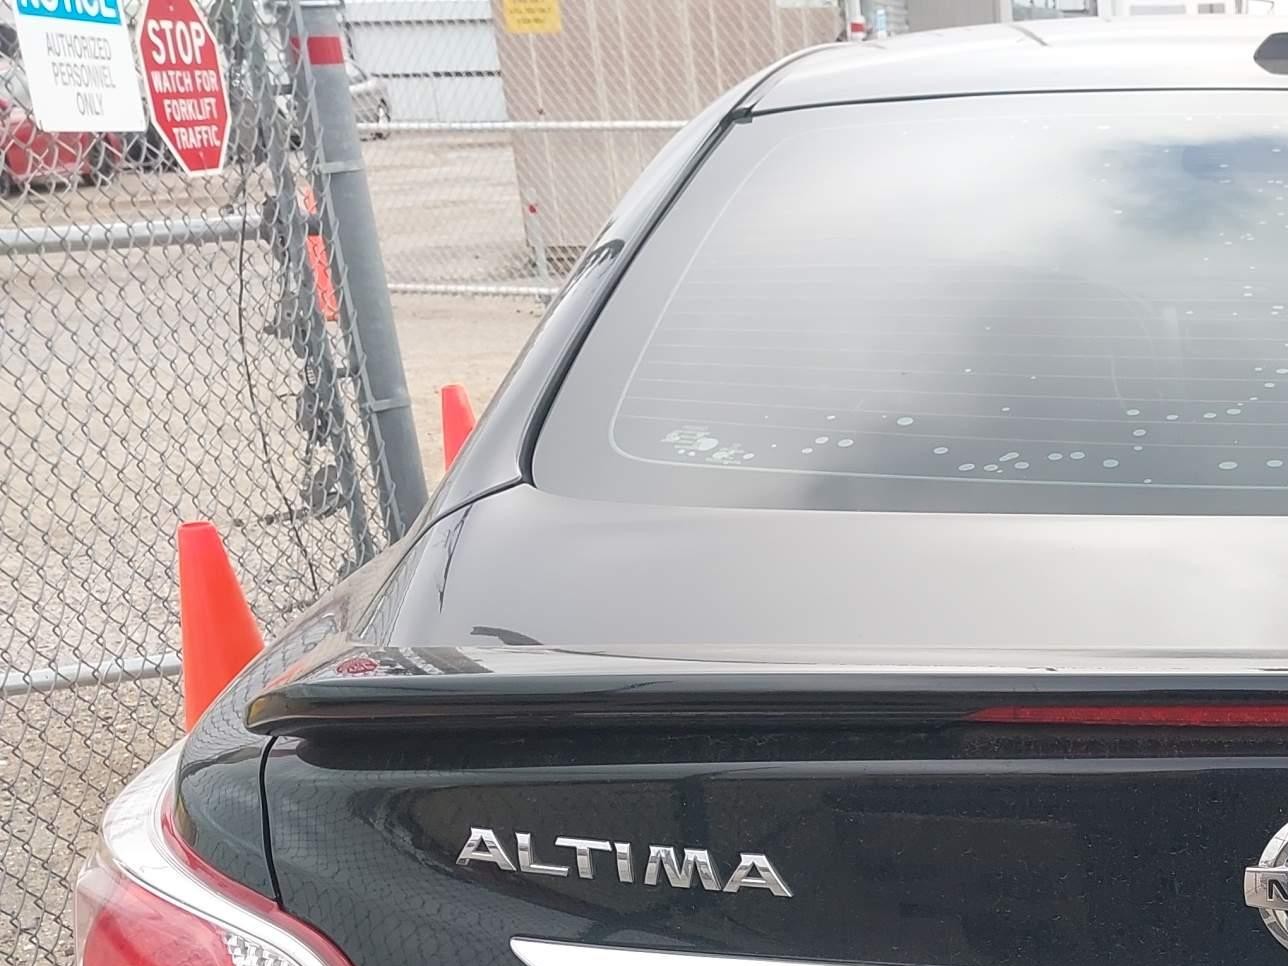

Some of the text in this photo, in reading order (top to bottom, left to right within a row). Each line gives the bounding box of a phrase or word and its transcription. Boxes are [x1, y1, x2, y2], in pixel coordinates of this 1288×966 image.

[46, 31, 112, 61] AUTHORIZED
[147, 19, 206, 65] STOP
[51, 62, 116, 88] PERSONNEL
[151, 69, 219, 94] WATCH FOR
[76, 91, 104, 116] ONLY
[163, 97, 217, 122] FORKLIFT
[172, 124, 221, 149] TRAFFIC
[456, 827, 793, 898] ALTIMA
